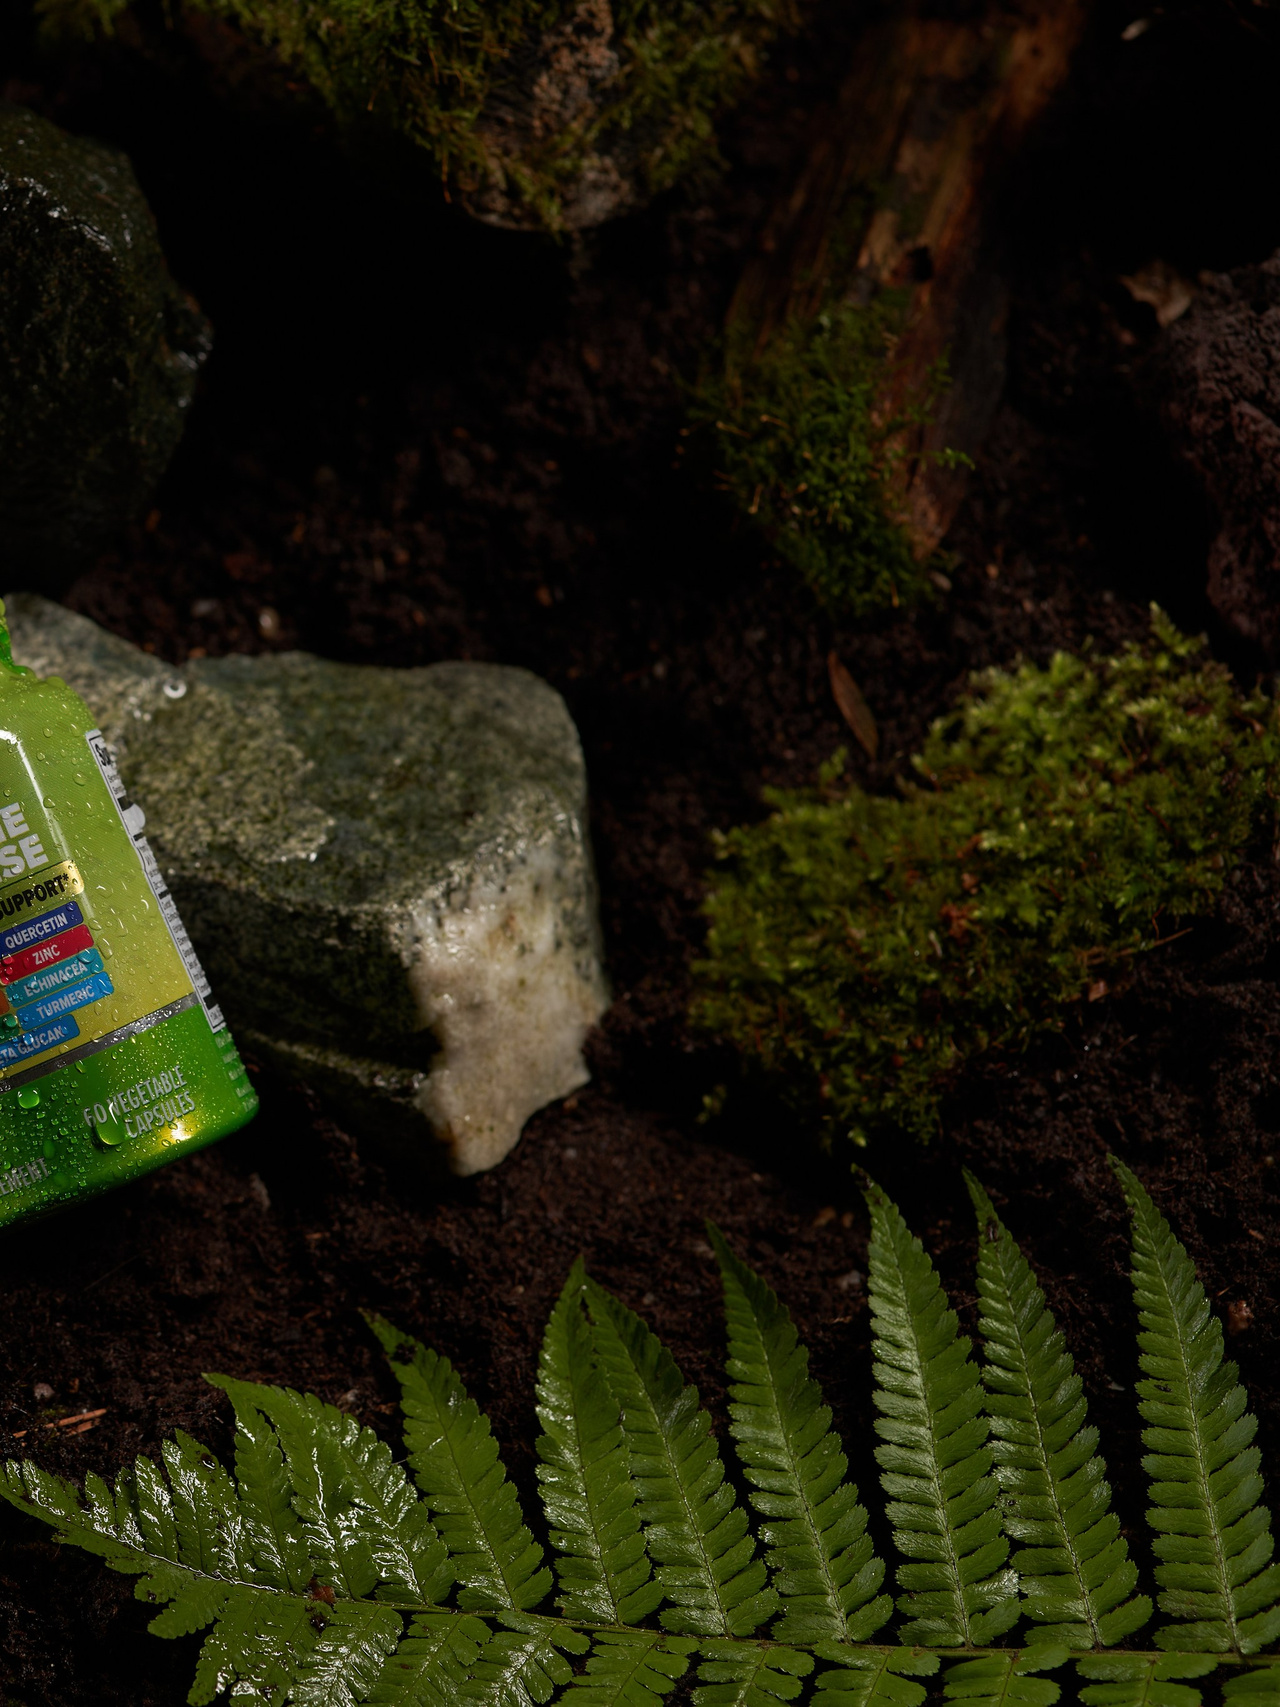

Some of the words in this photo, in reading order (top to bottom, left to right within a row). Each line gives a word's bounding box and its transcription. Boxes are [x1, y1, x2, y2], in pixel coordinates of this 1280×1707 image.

[4, 912, 69, 949] QUERCETIN
[32, 943, 61, 966] ZINC
[24, 961, 88, 998] ECHINACEA
[36, 985, 95, 1020] TURMERIC
[19, 1025, 65, 1055] GLUCAN
[106, 1065, 187, 1117] VEGETABLE
[124, 1090, 196, 1138] CAPSULES
